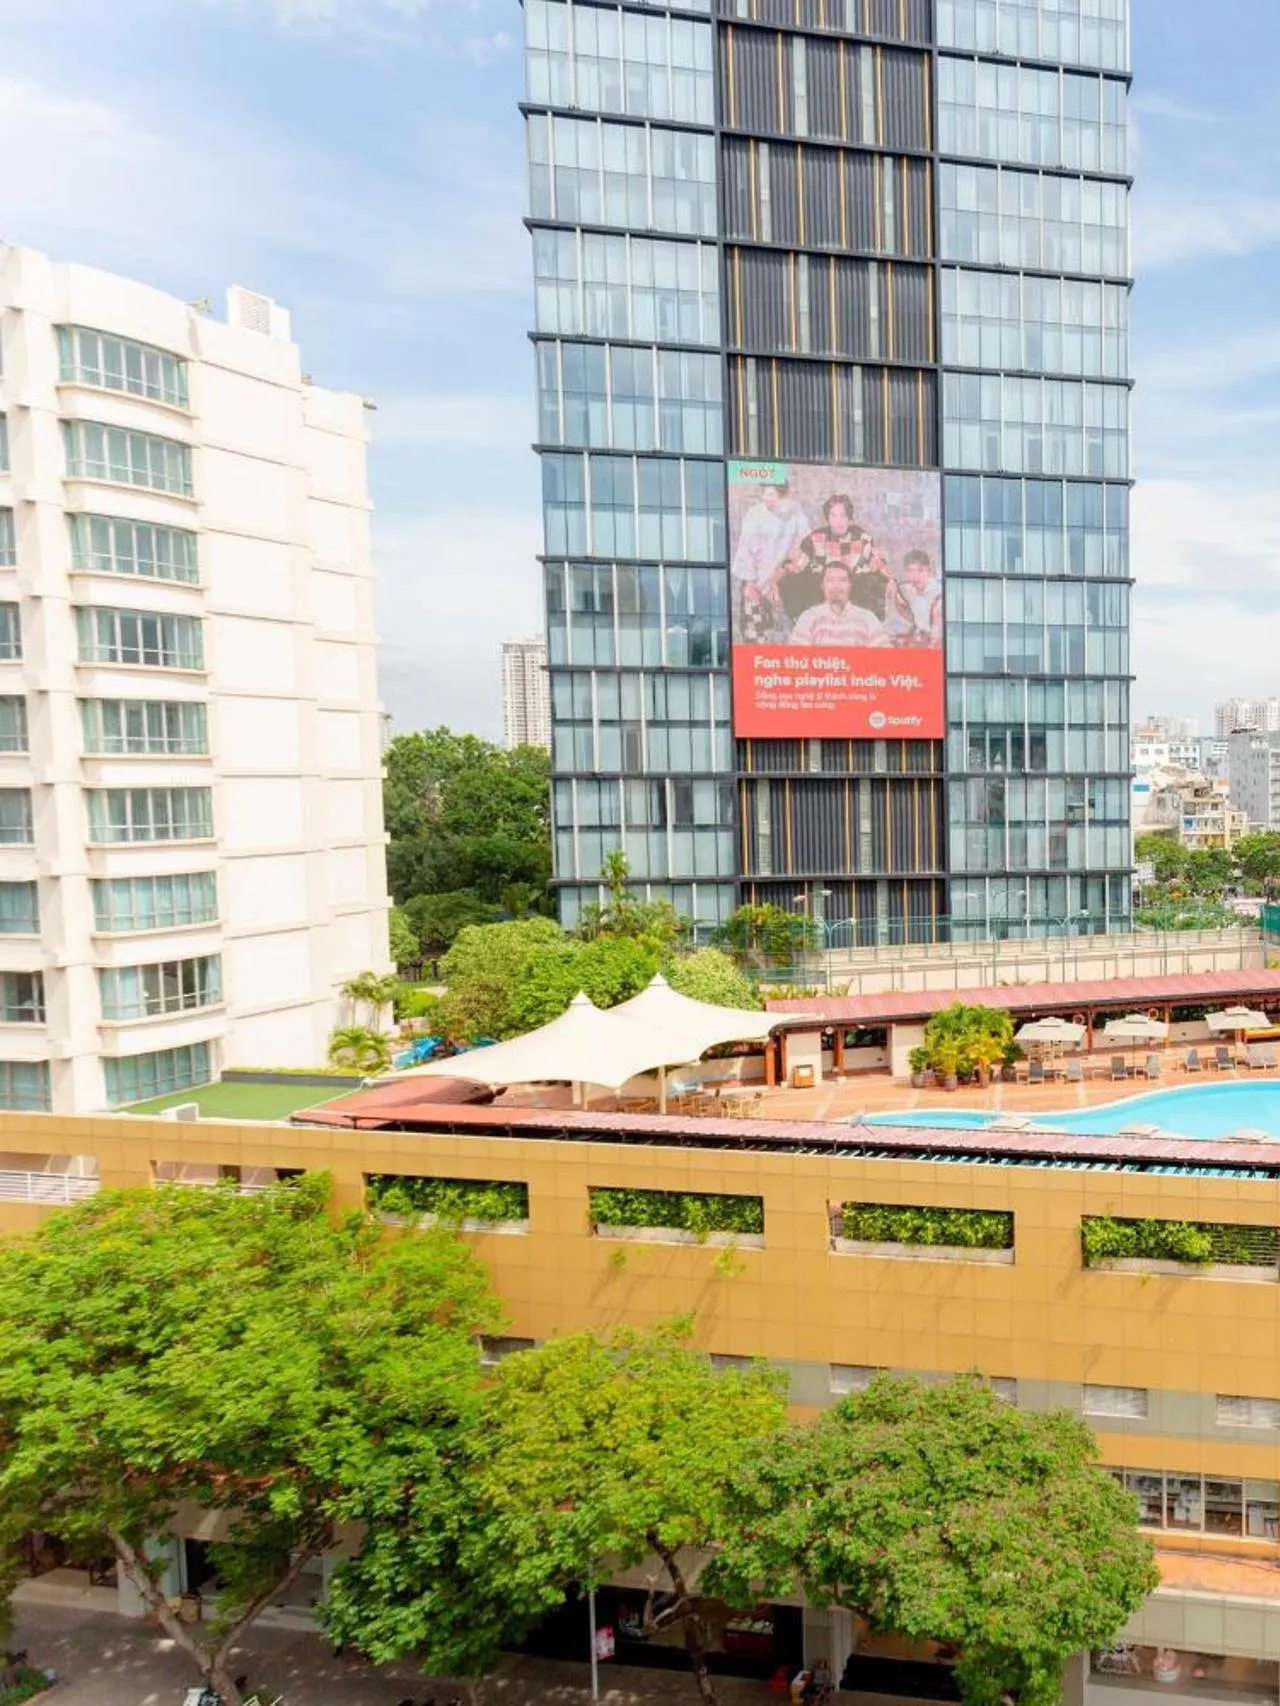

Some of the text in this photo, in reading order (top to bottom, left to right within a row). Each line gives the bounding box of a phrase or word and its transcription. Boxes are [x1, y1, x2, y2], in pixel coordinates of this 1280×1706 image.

[754, 656, 781, 670] Fan
[754, 674, 790, 689] nghe
[794, 674, 848, 690] playlist
[851, 674, 886, 688] Indie
[887, 714, 923, 728] Spotify
